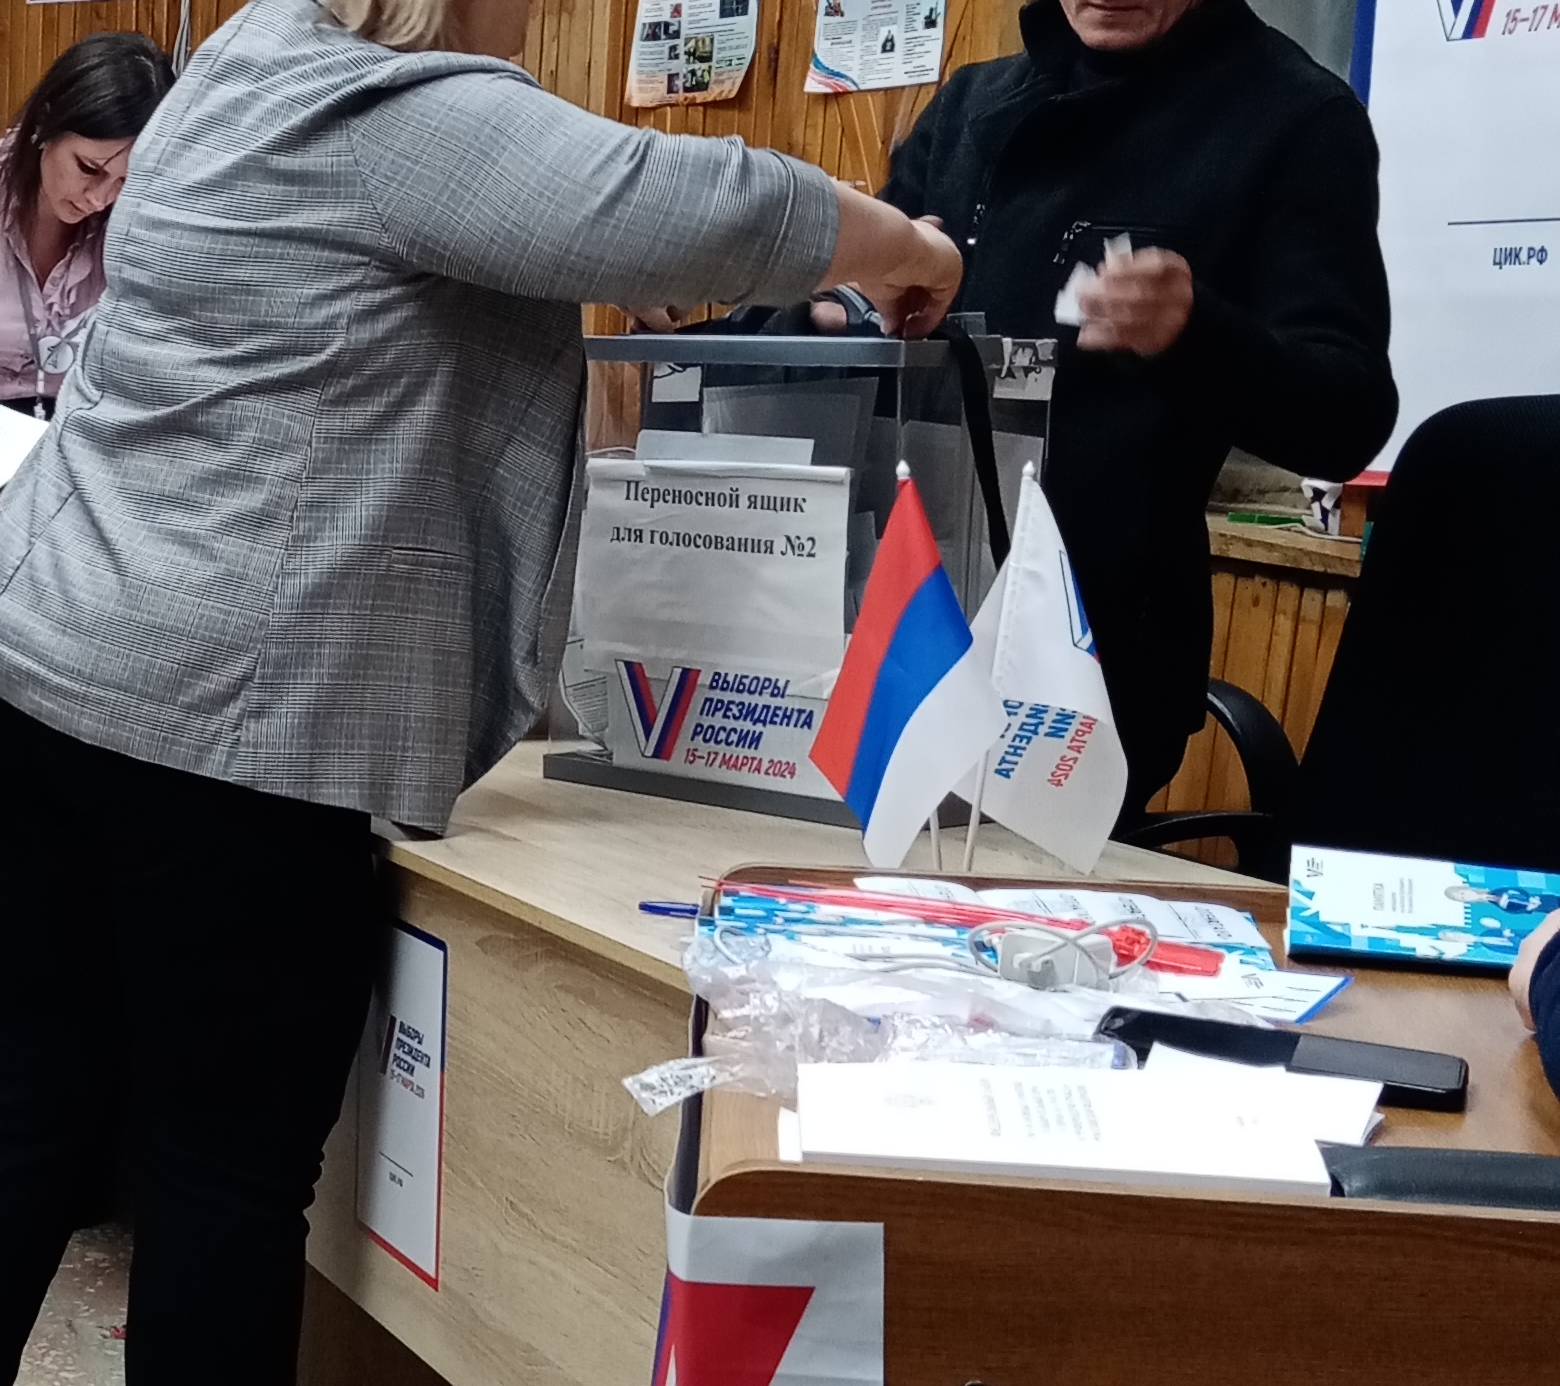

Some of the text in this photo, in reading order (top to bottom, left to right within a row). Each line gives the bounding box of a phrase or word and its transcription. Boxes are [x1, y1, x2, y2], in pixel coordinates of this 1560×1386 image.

[1492, 245, 1548, 270] ЦИК.РФ
[624, 480, 808, 514] Переносной ящик
[610, 526, 817, 558] для голосования №2
[708, 670, 791, 699] ВЫБОРЫ
[699, 696, 815, 731] ПРЕЗИДЕНТА
[690, 723, 764, 750] РОССИИ
[719, 752, 761, 775] МАРТА
[764, 759, 797, 780] 2024
